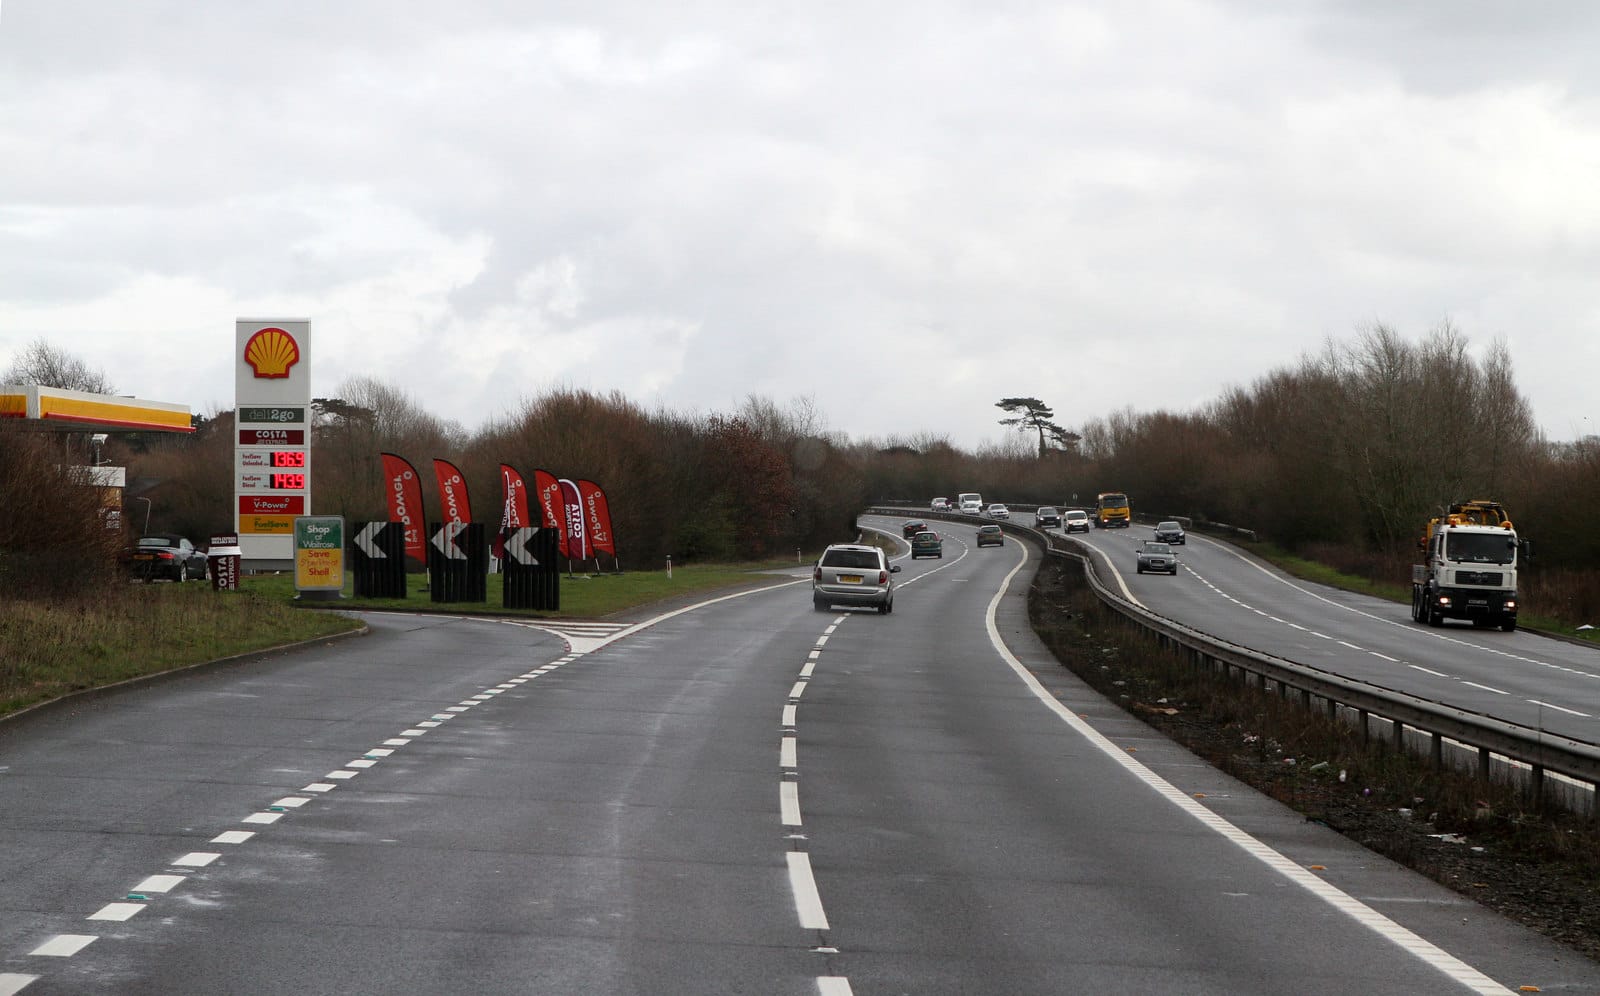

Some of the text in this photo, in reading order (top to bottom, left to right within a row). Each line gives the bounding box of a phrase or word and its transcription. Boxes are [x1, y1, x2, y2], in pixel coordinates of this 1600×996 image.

[249, 409, 294, 422] deli2go
[256, 431, 288, 439] COSTA
[307, 524, 330, 535] Shop
[303, 540, 334, 548] Waitrose
[308, 550, 330, 558] Save
[308, 568, 330, 576] Shell
